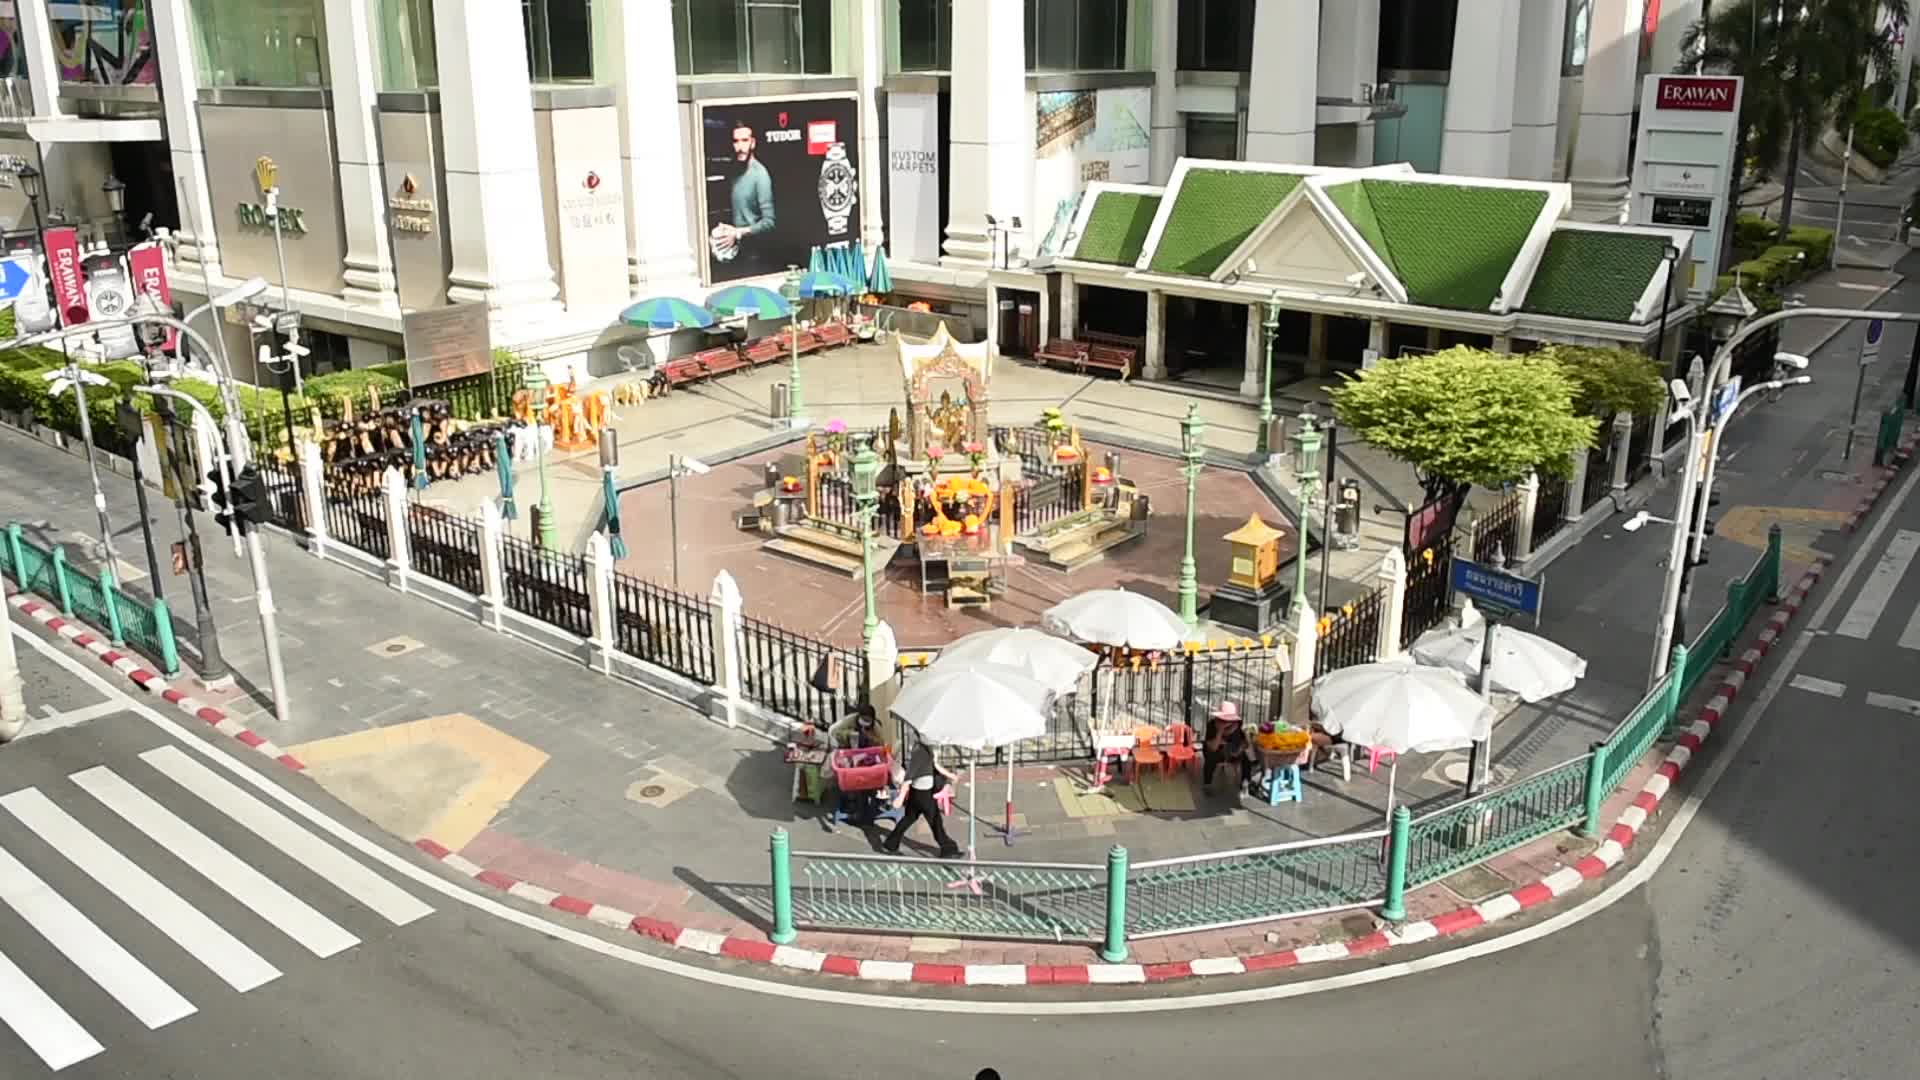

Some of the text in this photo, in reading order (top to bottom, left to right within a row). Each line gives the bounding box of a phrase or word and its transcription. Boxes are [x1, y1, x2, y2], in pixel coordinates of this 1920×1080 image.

[1664, 85, 1728, 100] ERAWAN
[765, 130, 801, 142] TUDOR
[892, 151, 935, 161] KUSTOM
[892, 162, 936, 174] KARPETS
[57, 248, 81, 306] ERAWAN
